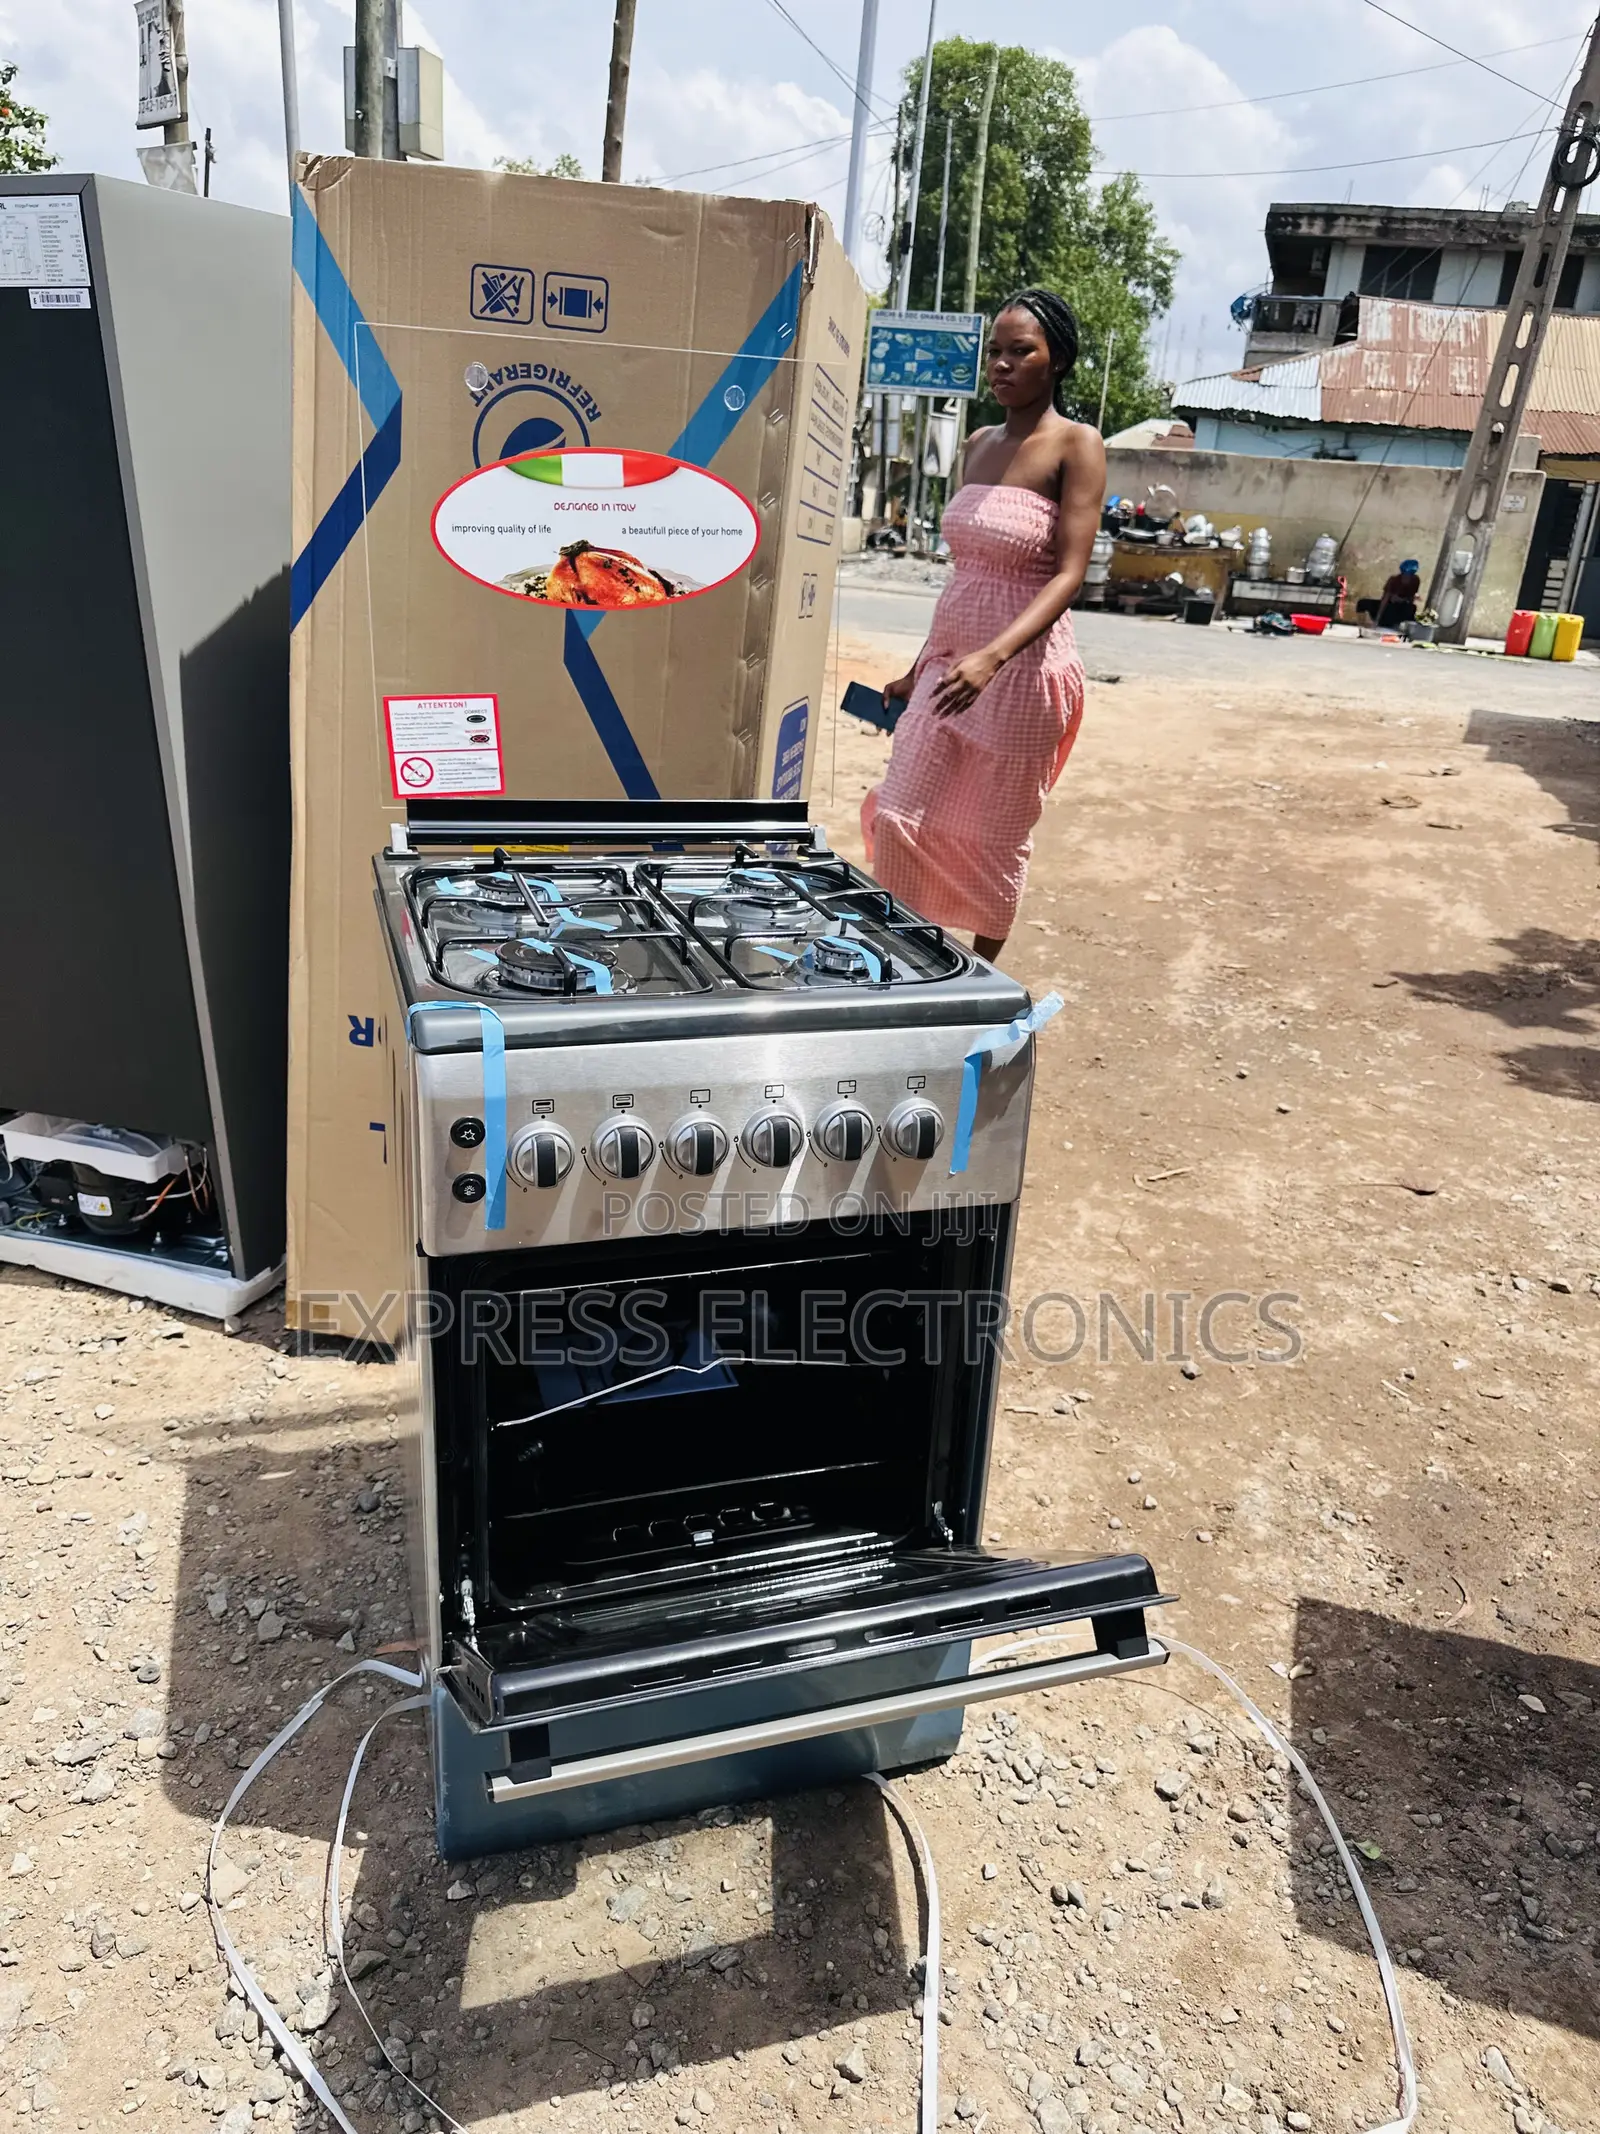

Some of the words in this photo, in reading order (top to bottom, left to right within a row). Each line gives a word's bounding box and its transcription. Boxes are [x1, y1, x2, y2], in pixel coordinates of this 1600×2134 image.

[469, 362, 602, 423] REFRIGERANT
[553, 502, 599, 511] DESIGNED
[601, 503, 611, 511] IN
[613, 503, 636, 512] ITALY
[451, 523, 495, 535] improving
[497, 523, 526, 535] quality
[528, 524, 537, 534] of
[538, 524, 552, 534] life
[621, 527, 627, 535] a
[628, 526, 667, 535] beautifull
[668, 527, 690, 537] piece
[691, 526, 700, 536] of
[701, 528, 719, 538] your
[721, 527, 743, 536] home
[417, 701, 468, 710] ATTENTION!
